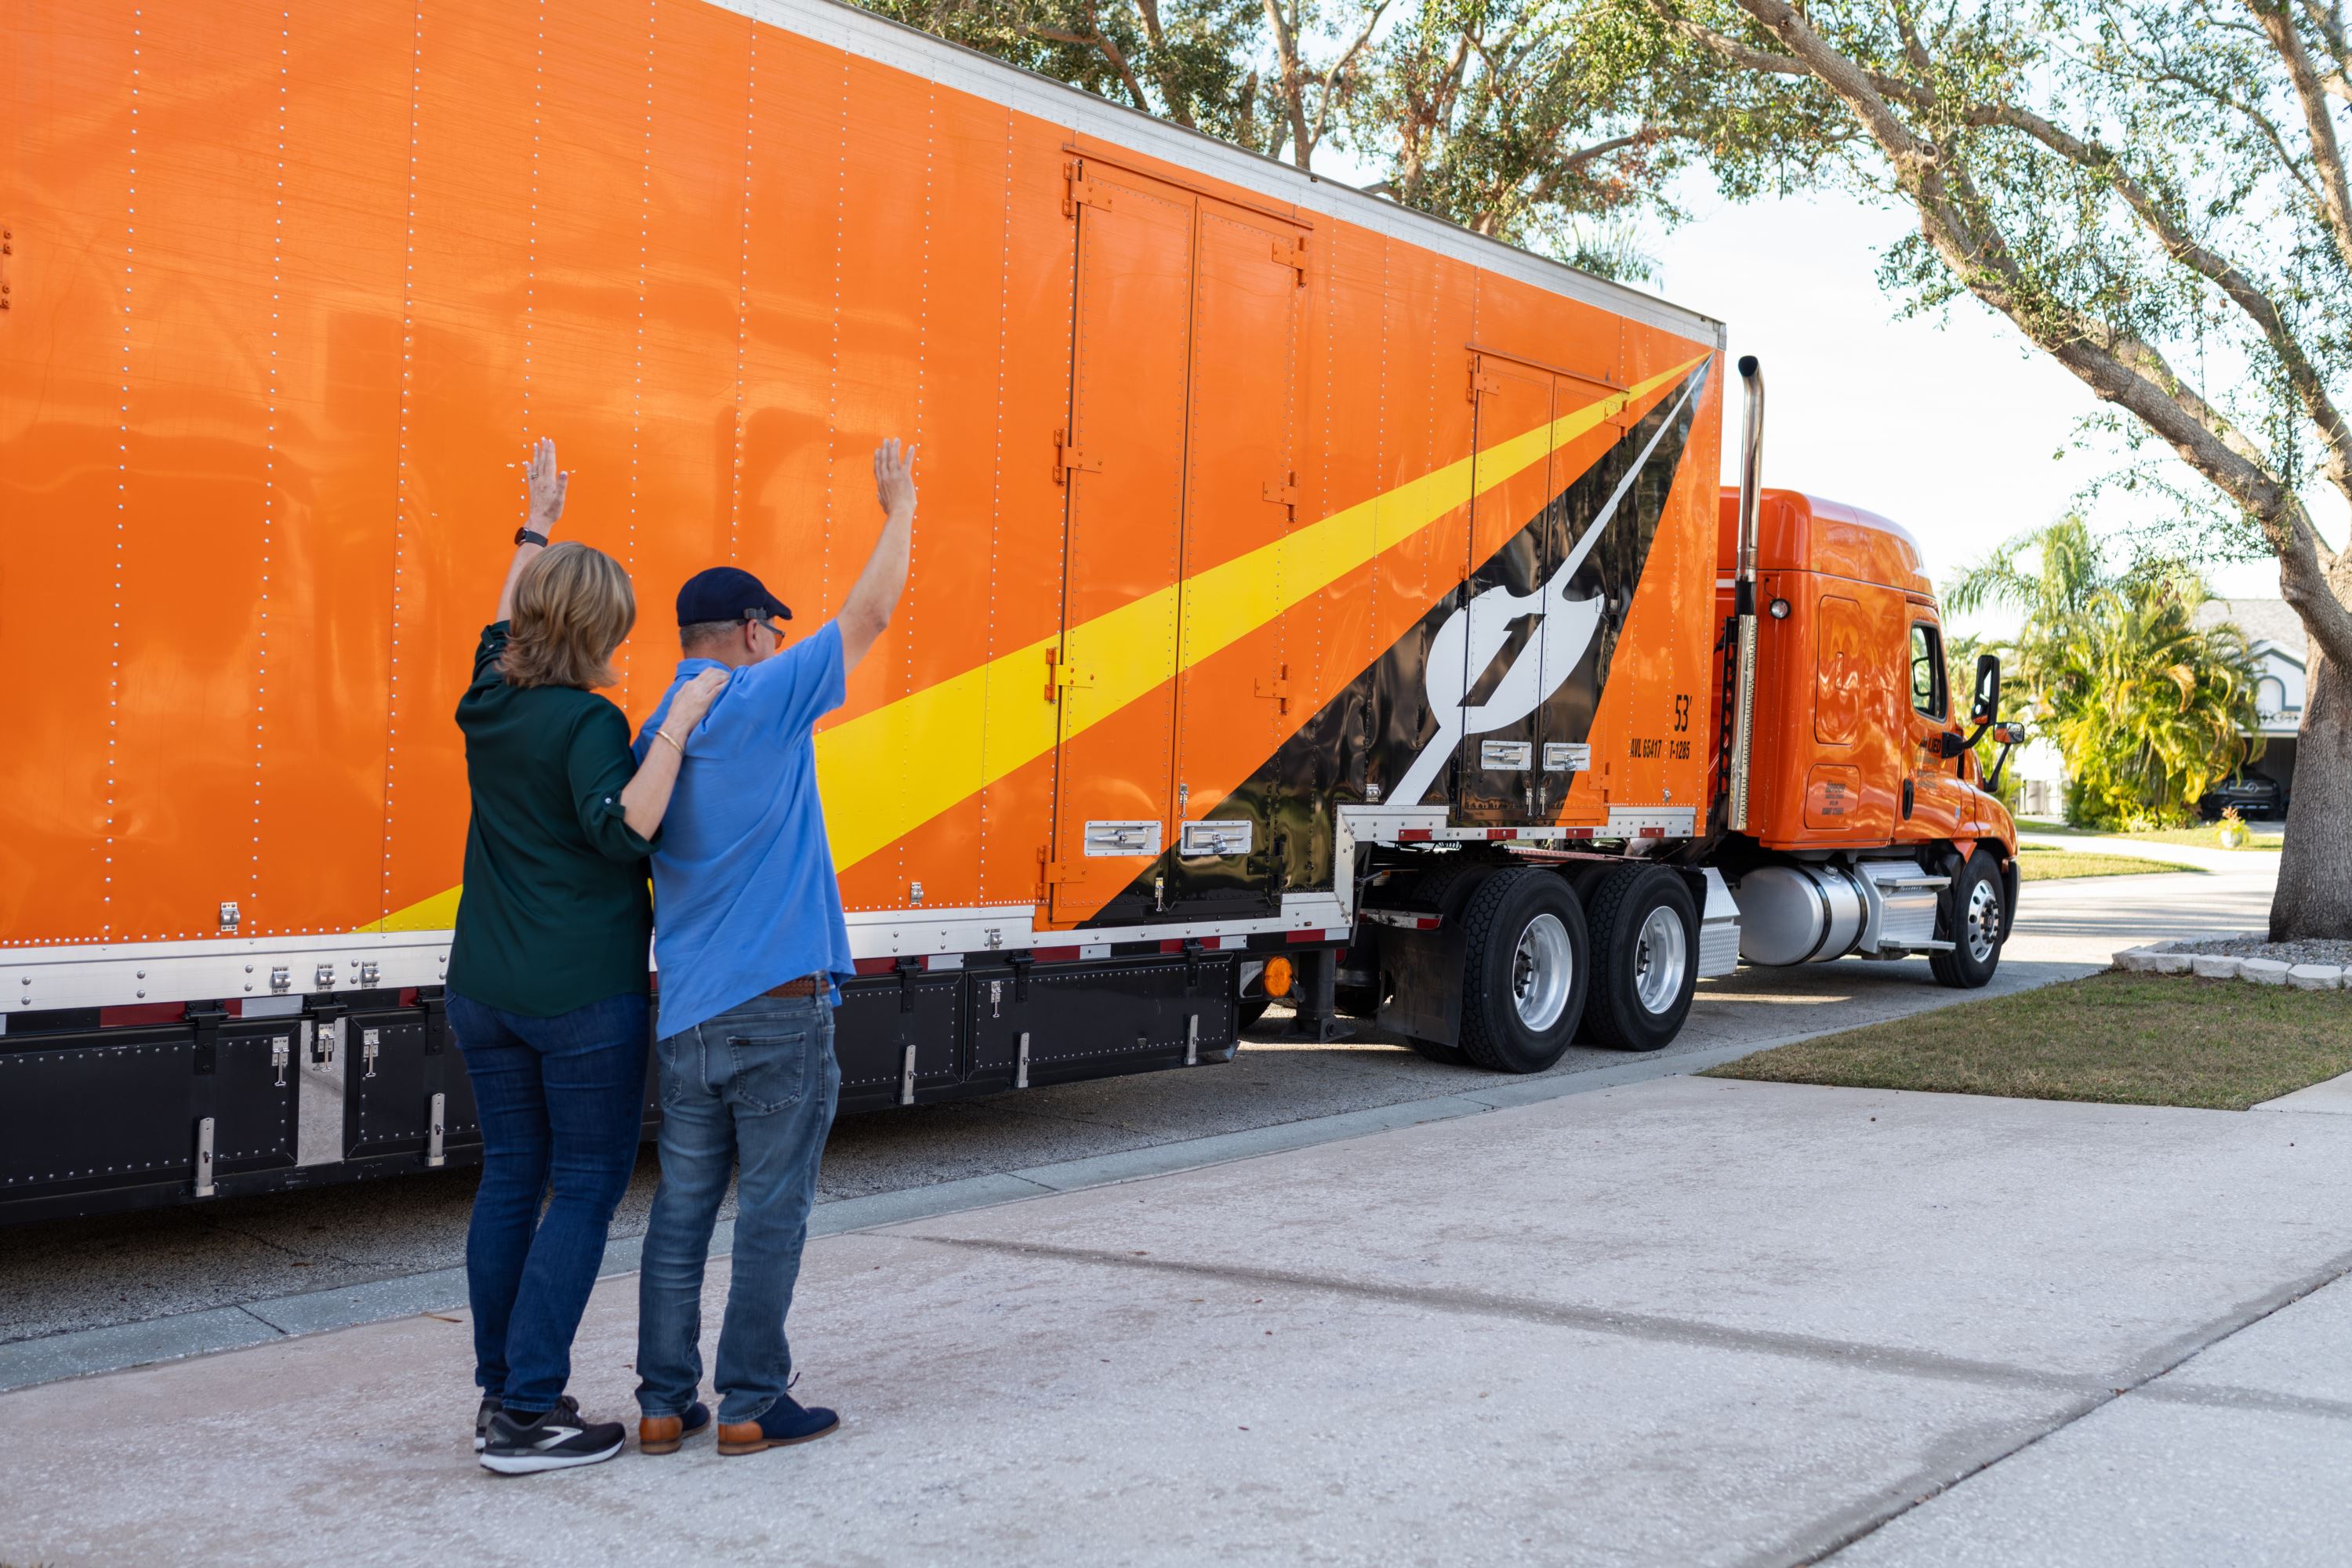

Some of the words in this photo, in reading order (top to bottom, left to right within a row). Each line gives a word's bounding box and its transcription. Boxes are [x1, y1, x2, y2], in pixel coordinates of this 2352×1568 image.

[1630, 739, 1641, 758] AVL
[1643, 739, 1662, 758] 65417
[1670, 740, 1690, 760] T-1285
